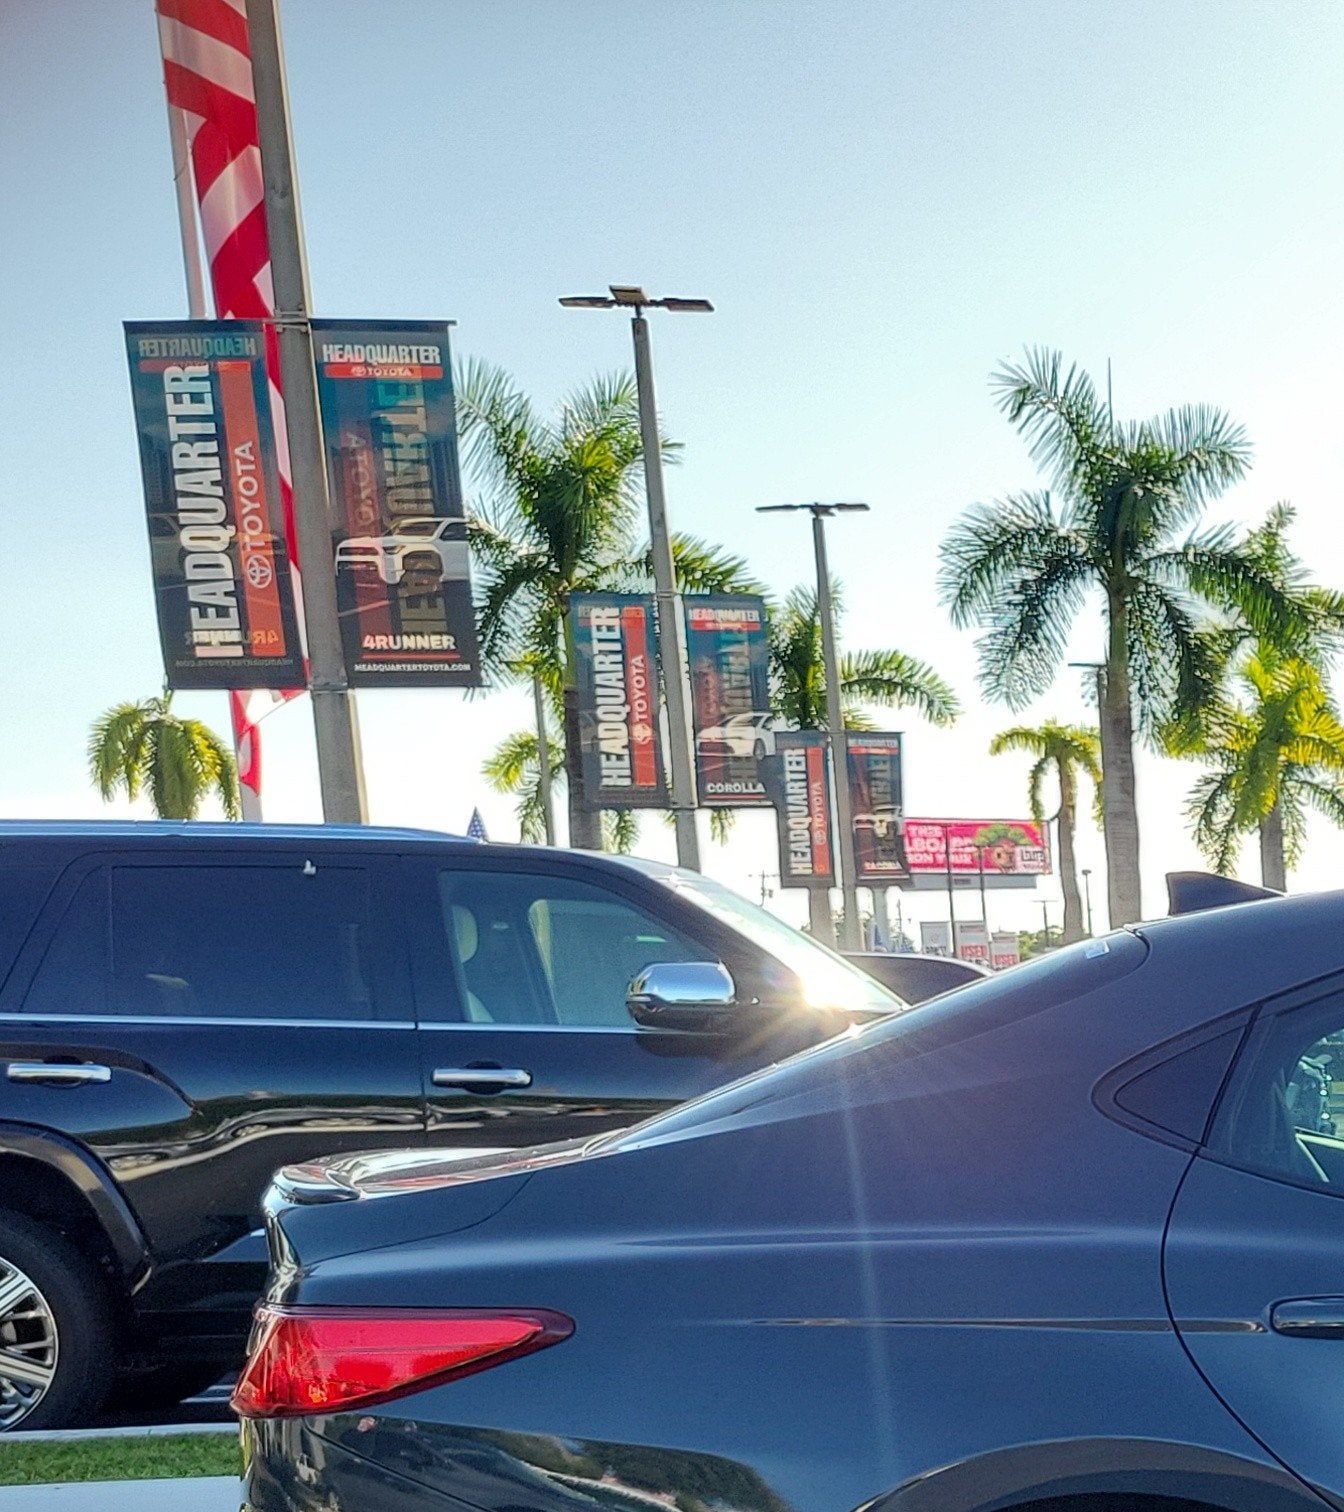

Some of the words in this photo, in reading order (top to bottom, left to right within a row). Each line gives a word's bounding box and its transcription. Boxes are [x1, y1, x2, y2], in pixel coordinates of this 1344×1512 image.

[322, 344, 441, 366] HEADQUARTER
[368, 366, 413, 377] TOYOTA
[163, 362, 244, 657] HEADQUARTER
[234, 441, 264, 550] TOYOTA
[362, 634, 457, 650] 4RUNNER
[591, 606, 632, 787] HEADQUARTER
[631, 654, 648, 721] TOYOTA
[706, 782, 767, 793] COROLLA
[784, 748, 813, 875] HEADQUARTER
